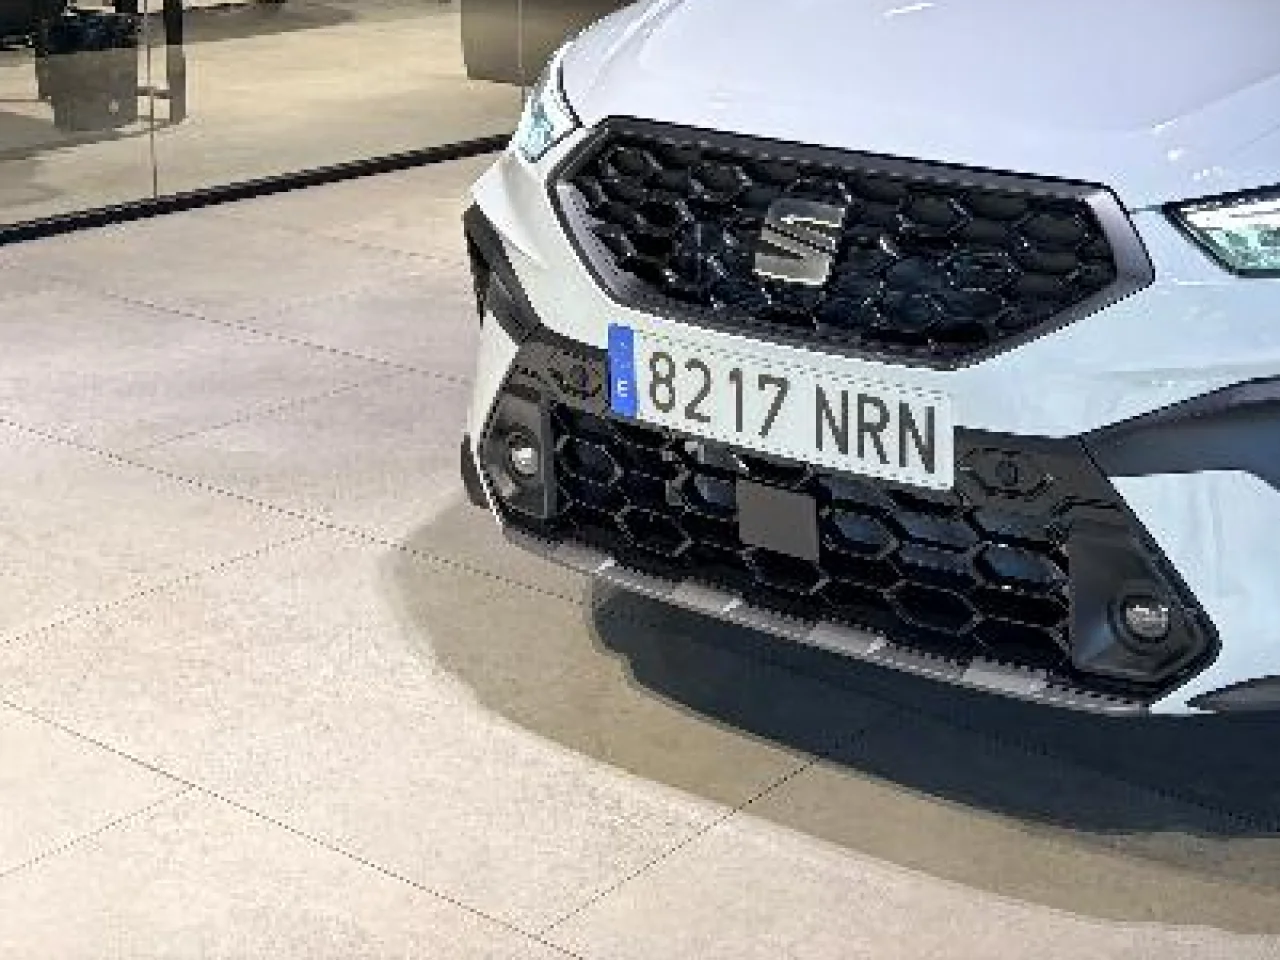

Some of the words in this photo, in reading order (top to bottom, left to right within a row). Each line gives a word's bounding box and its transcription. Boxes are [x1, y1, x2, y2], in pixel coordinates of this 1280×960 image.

[616, 379, 629, 398] E
[648, 351, 789, 438] 8217
[814, 383, 936, 475] NRN
